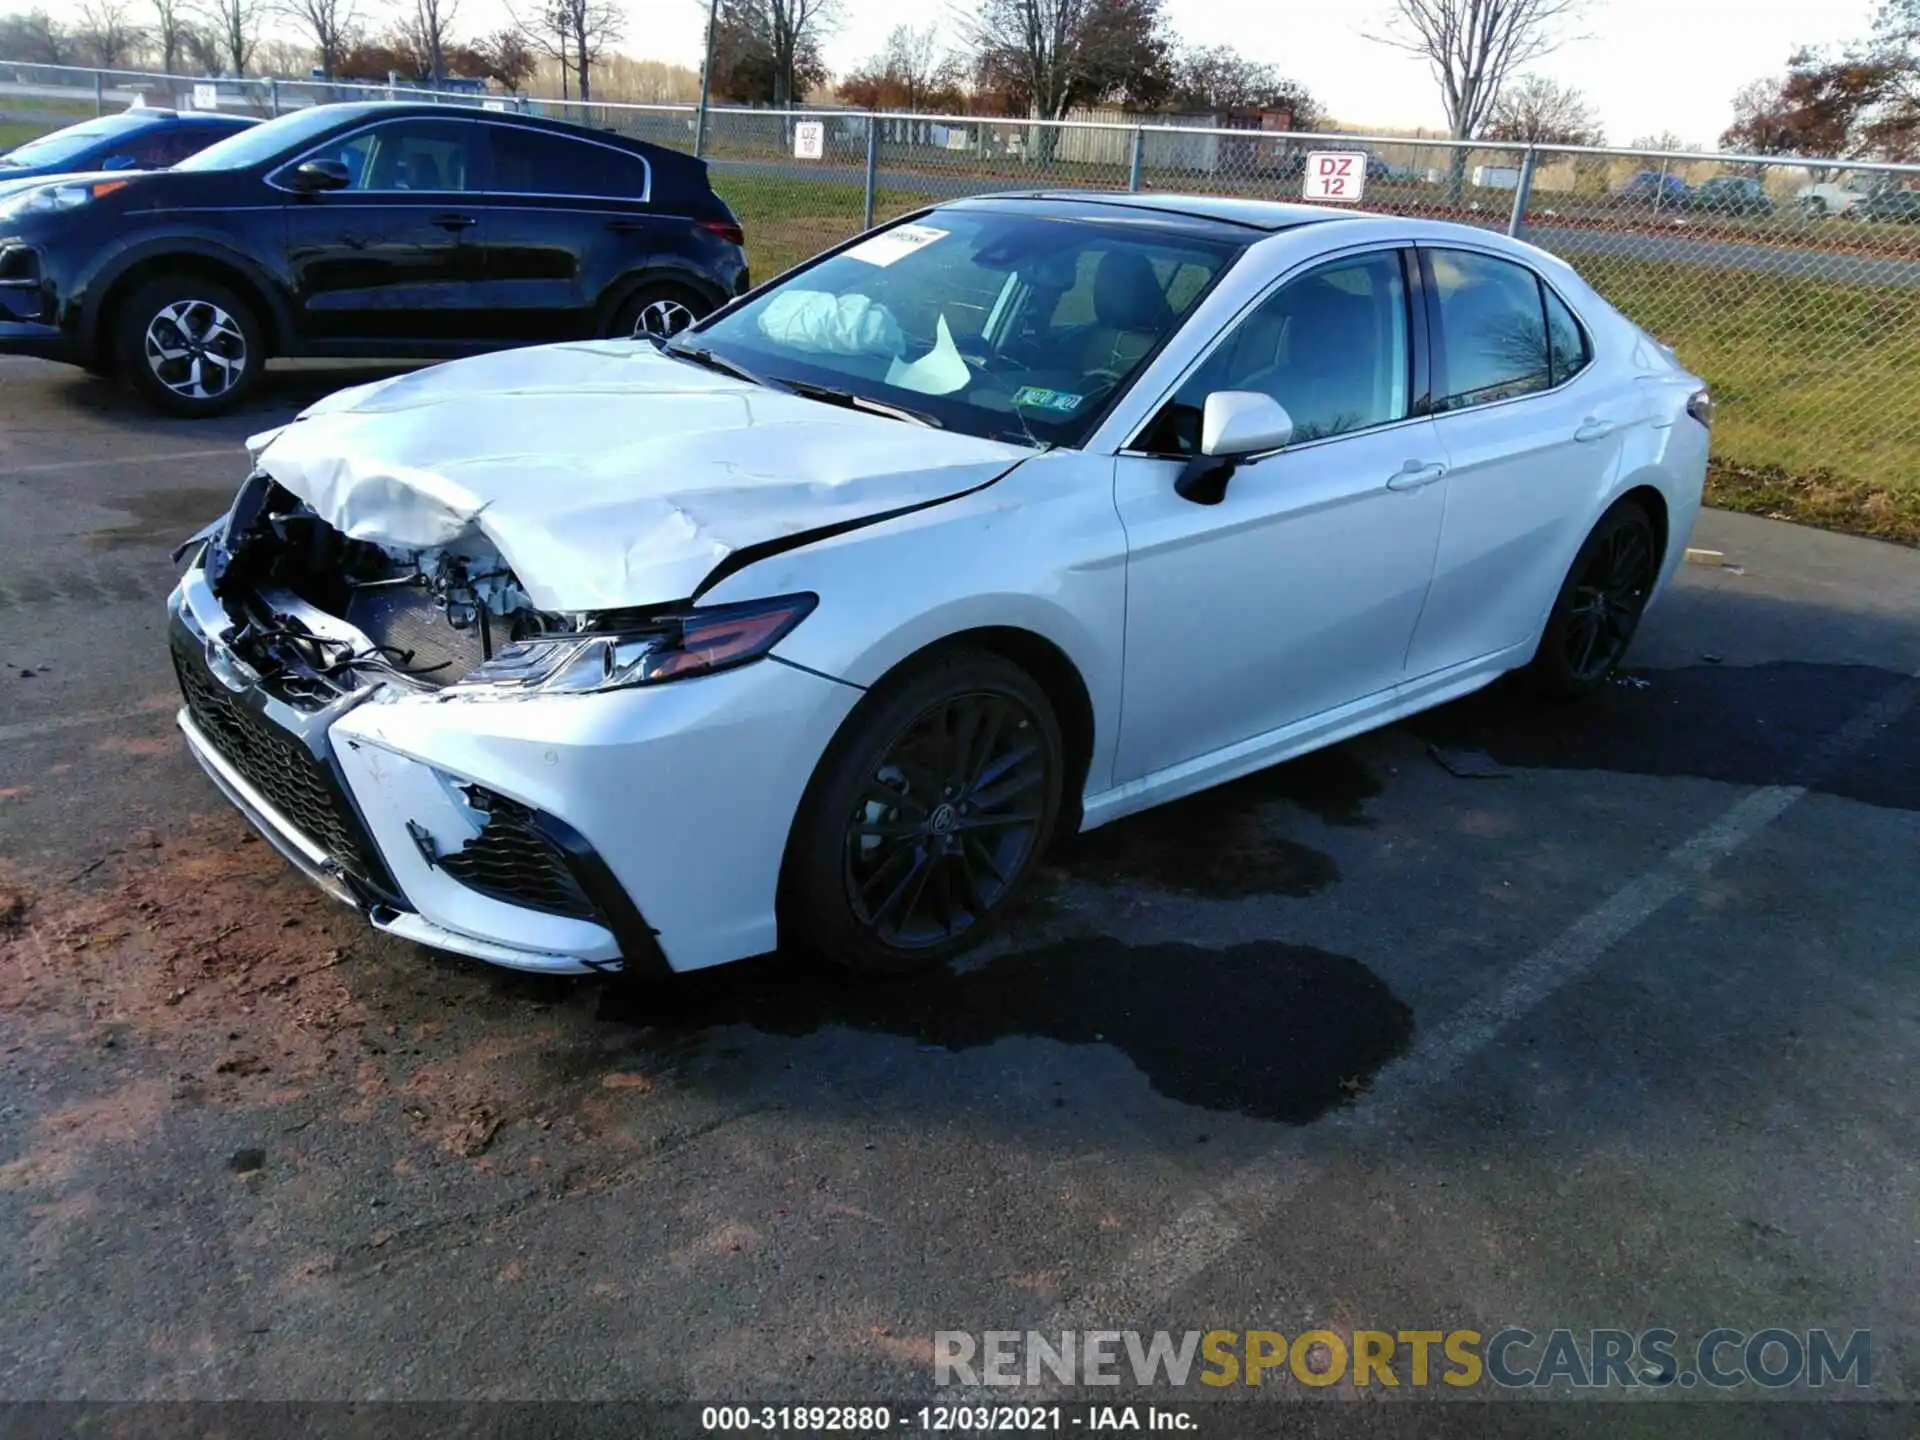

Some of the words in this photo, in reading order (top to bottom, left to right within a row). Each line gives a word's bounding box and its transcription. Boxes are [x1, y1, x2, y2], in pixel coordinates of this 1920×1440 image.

[804, 141, 815, 152] 10
[1320, 158, 1352, 176] DZ
[1321, 178, 1345, 195] 12
